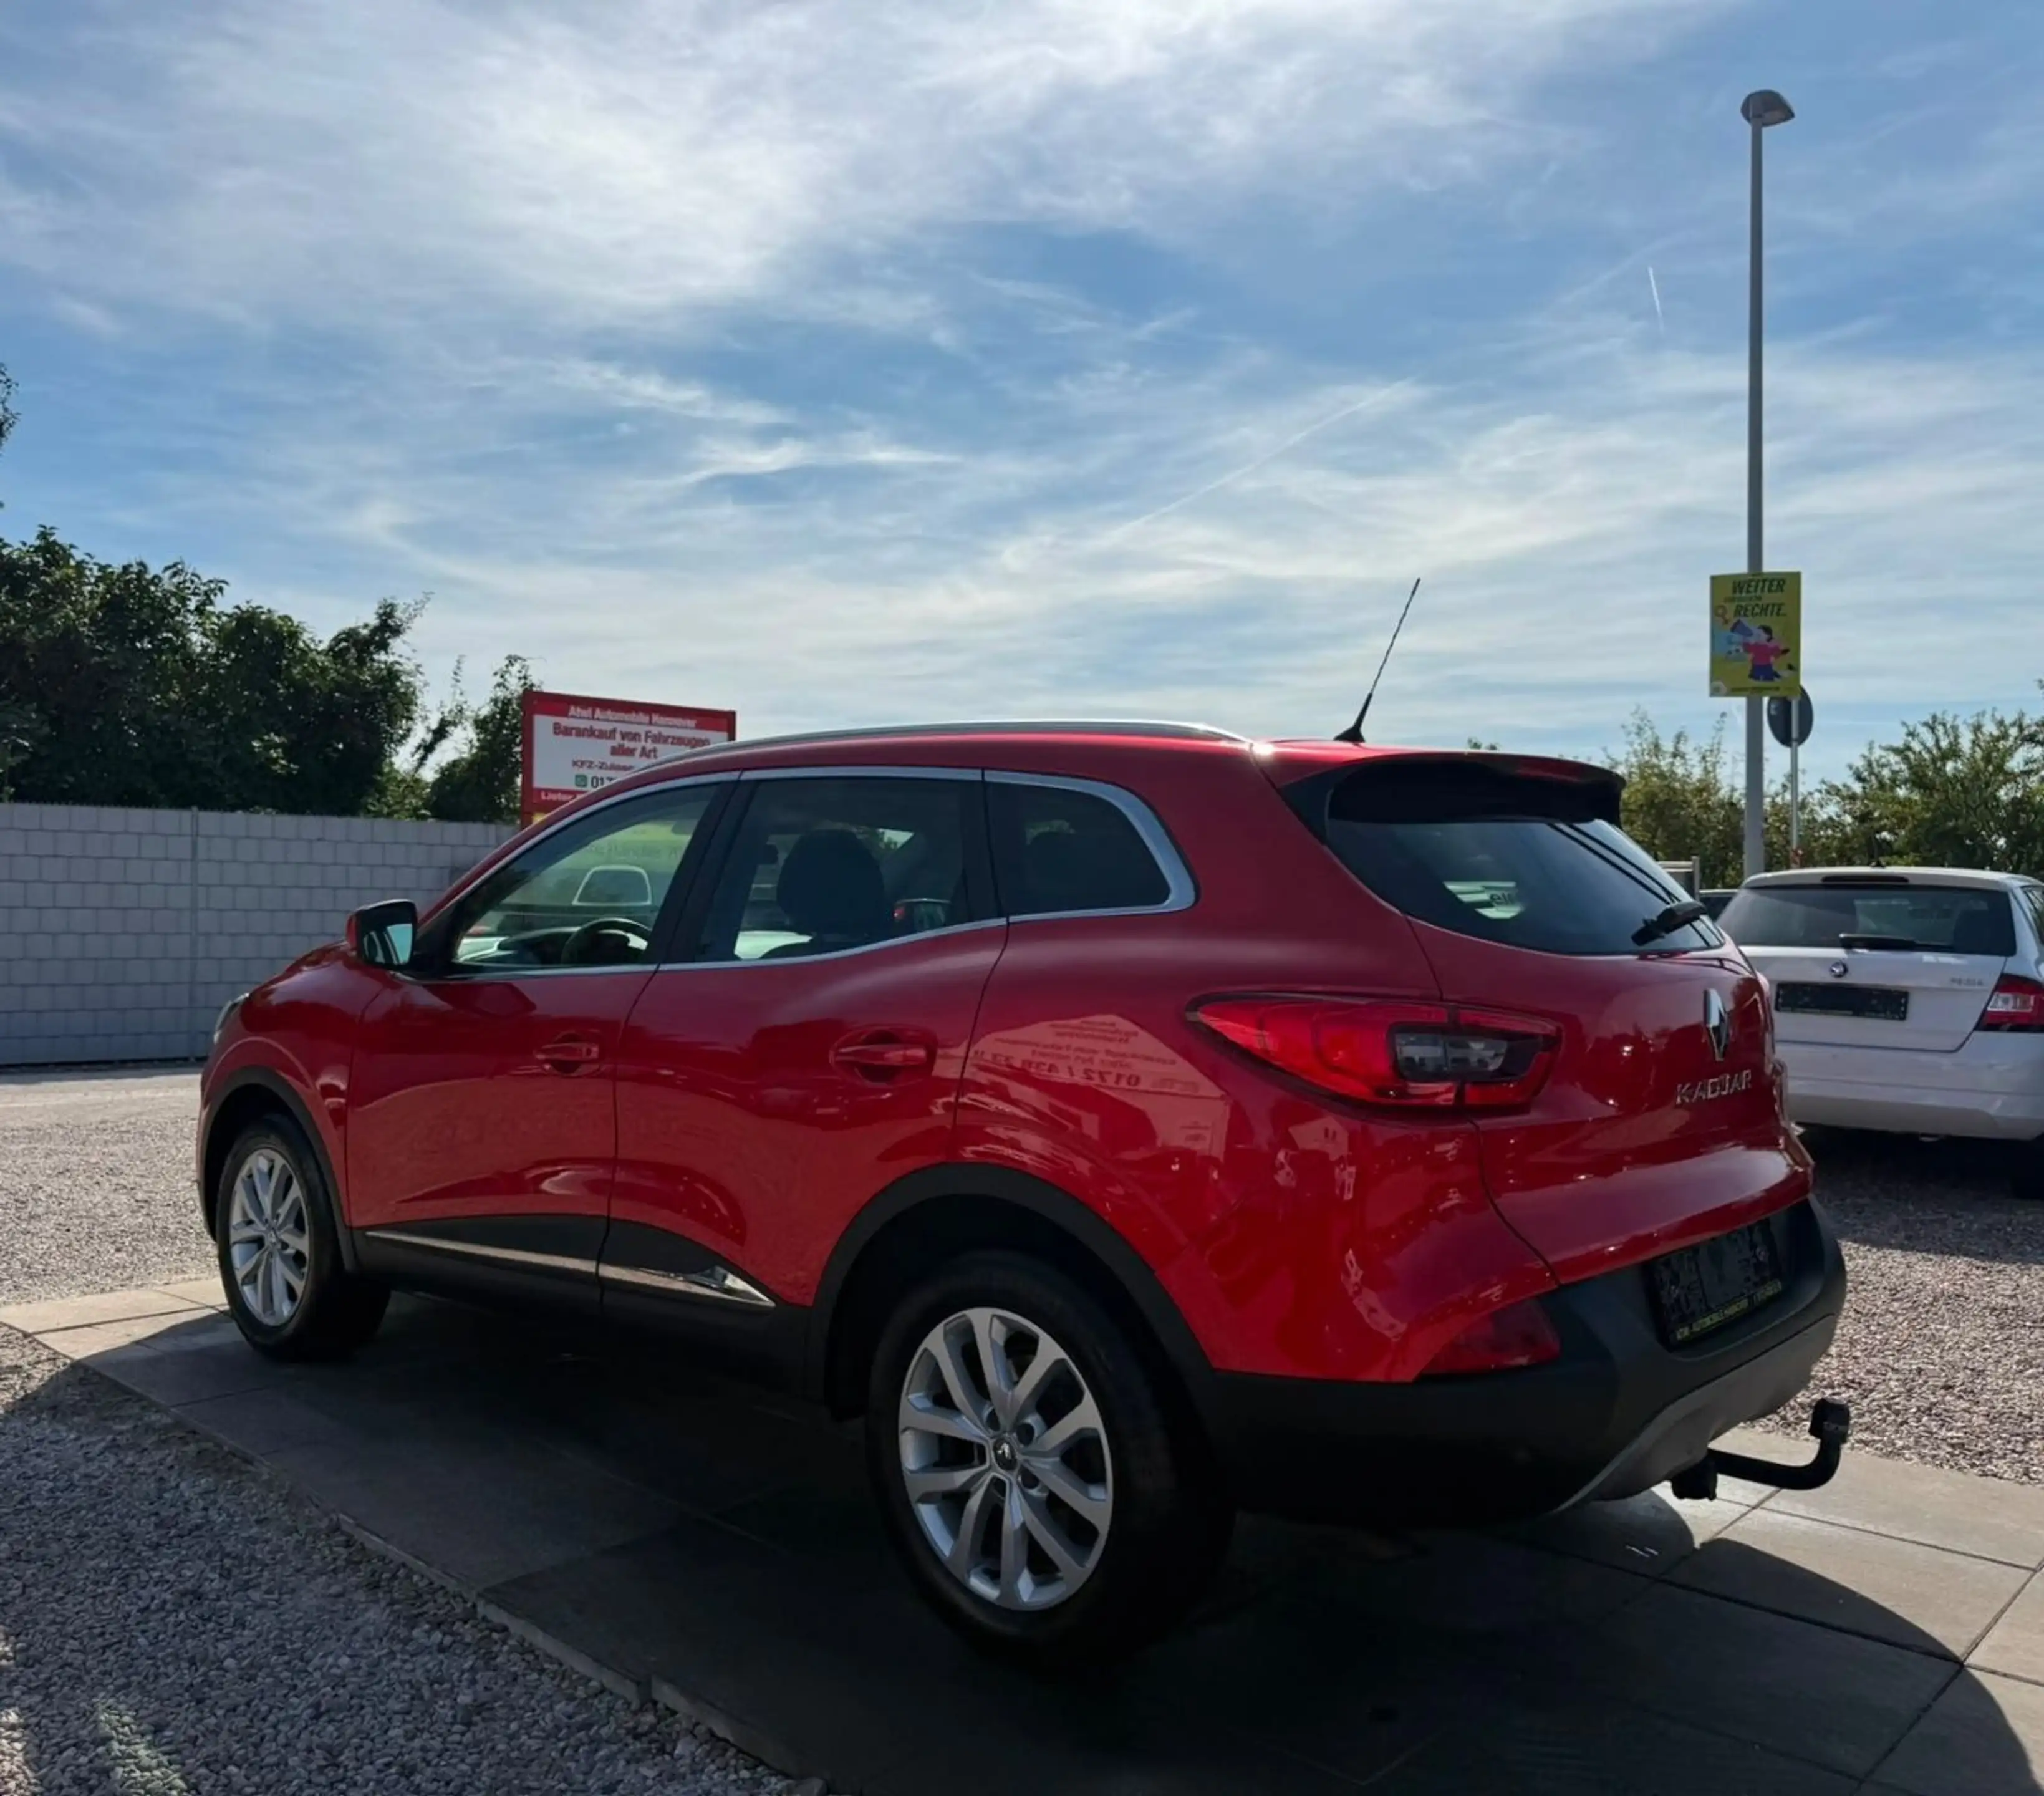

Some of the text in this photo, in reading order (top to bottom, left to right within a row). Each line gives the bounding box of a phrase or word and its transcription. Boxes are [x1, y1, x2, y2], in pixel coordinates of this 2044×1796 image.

[1732, 578, 1786, 595] WEITER
[552, 722, 710, 748] Barankauf von Fahrzeugen
[610, 745, 658, 760] aller Art
[1675, 1069, 1752, 1105] KADJAR
